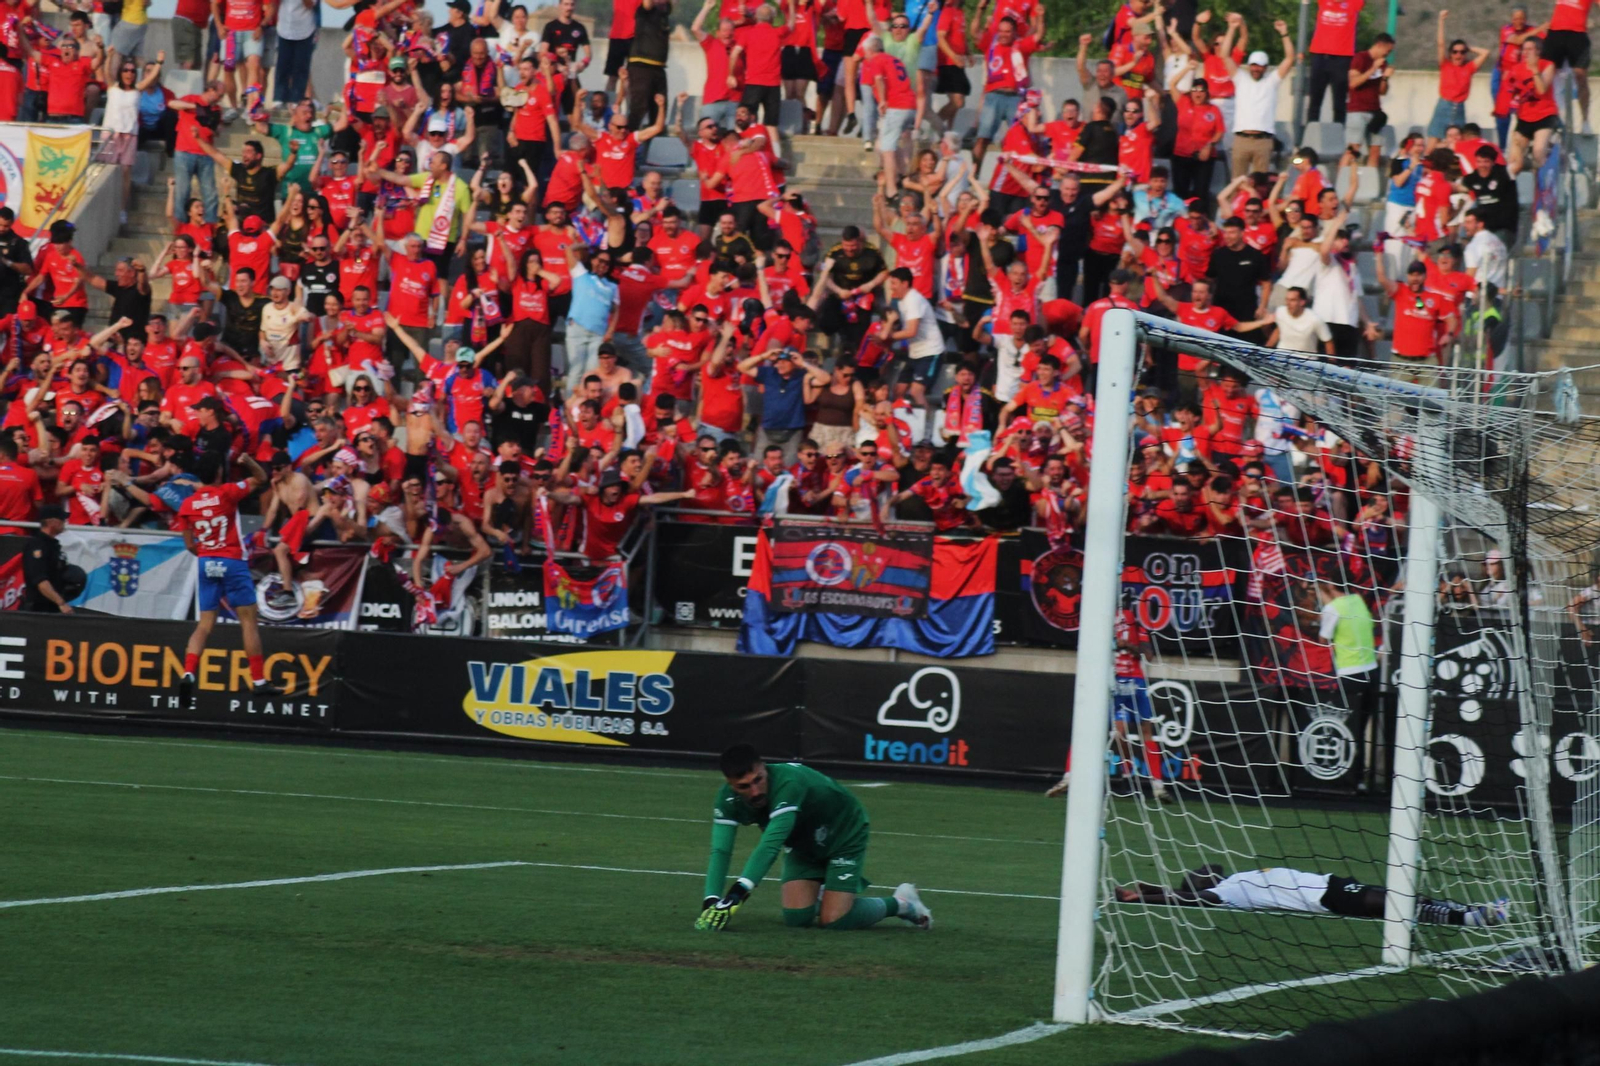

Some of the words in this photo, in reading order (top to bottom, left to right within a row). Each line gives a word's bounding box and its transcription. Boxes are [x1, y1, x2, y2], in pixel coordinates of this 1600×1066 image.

[194, 515, 228, 547] 27
[487, 589, 540, 607] UNIÓN
[45, 639, 333, 697] BIOENERGY
[0, 686, 21, 699] D
[53, 689, 117, 705] WITH
[230, 699, 329, 717] PLANET
[467, 660, 675, 716] VIALES
[474, 709, 486, 725] Y
[490, 710, 547, 728] OBRAS
[551, 710, 636, 735] PÚBLICAS
[864, 733, 969, 766] trendit
